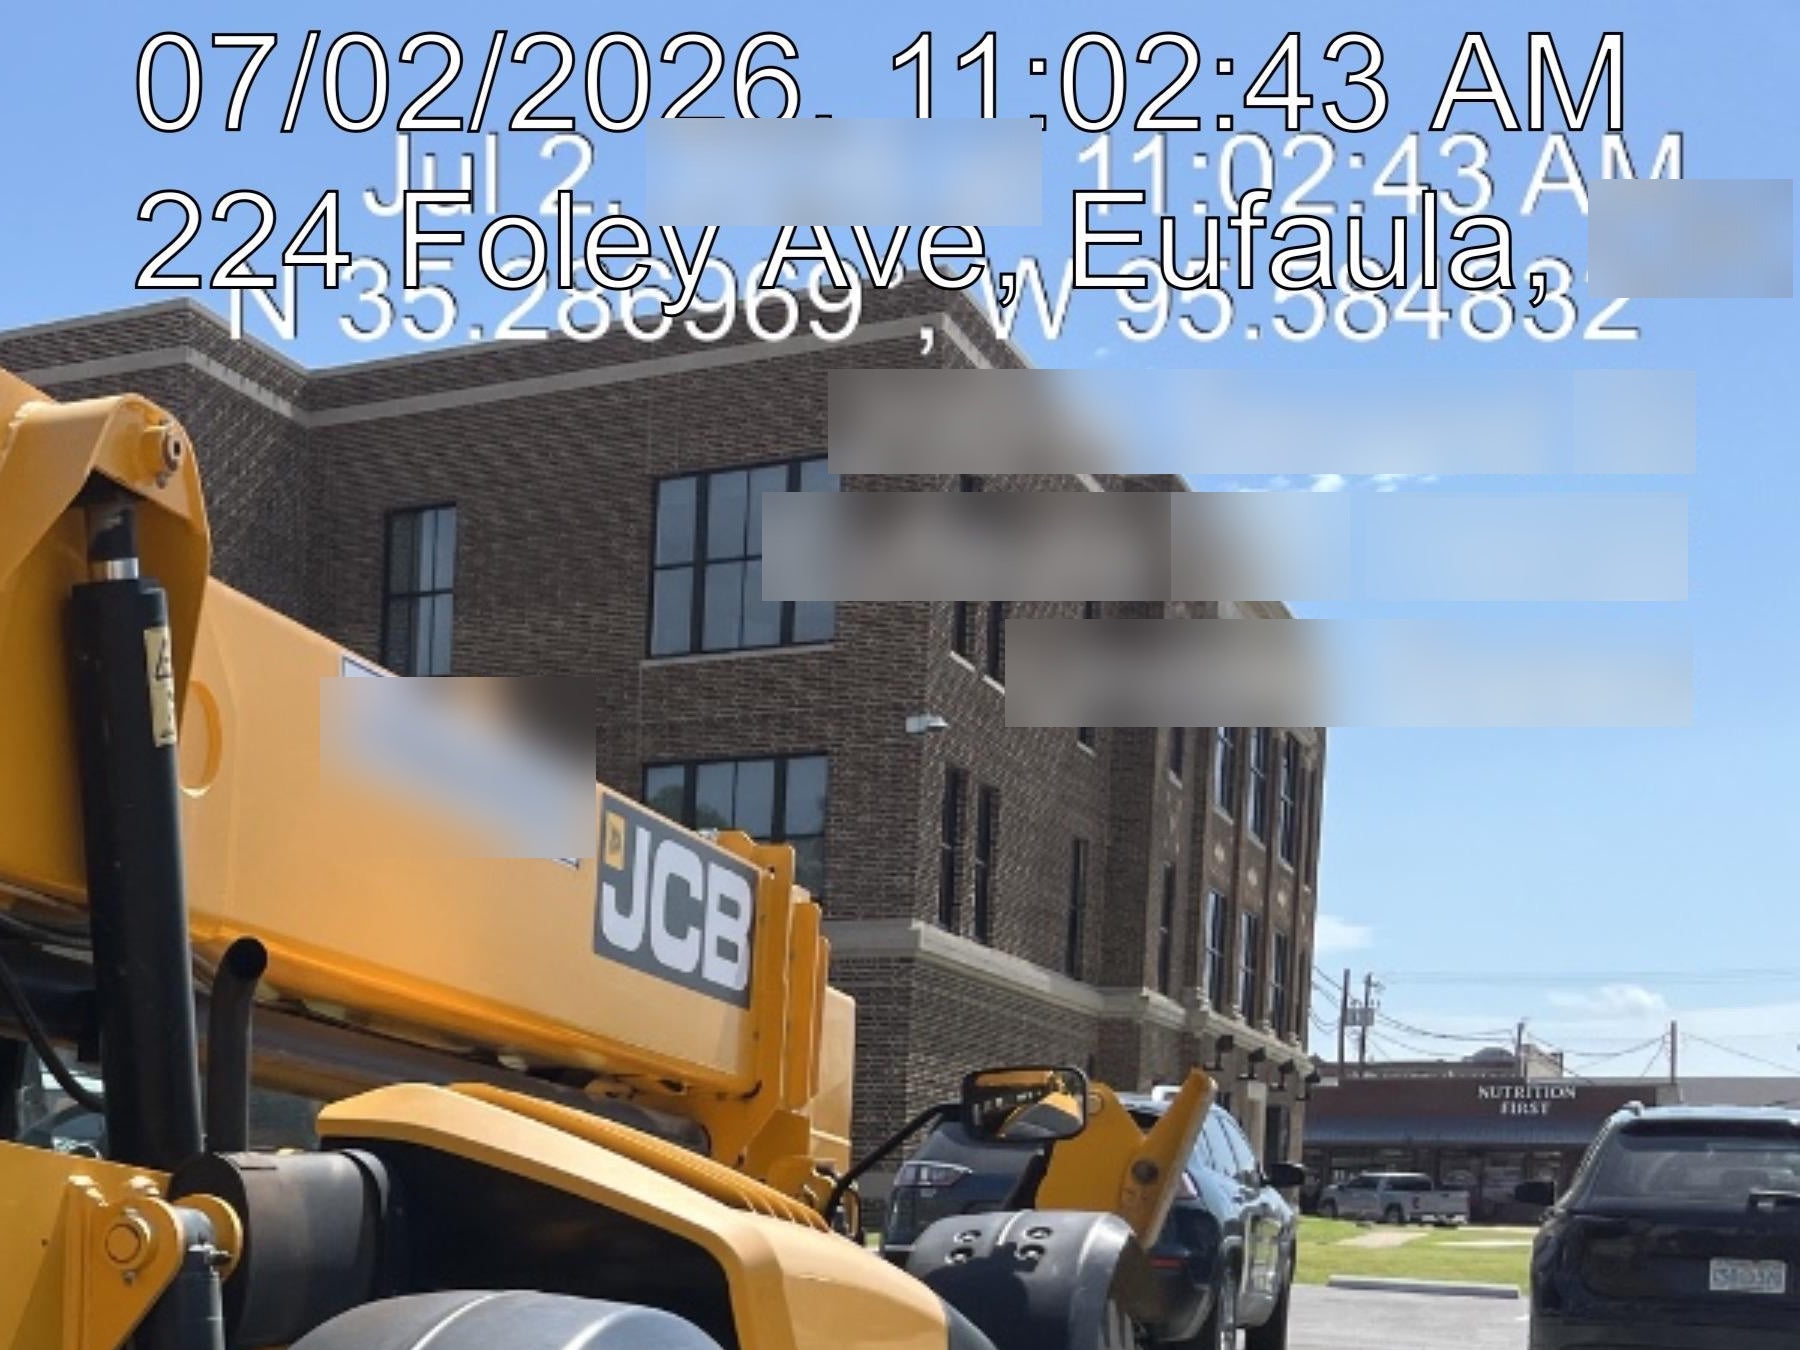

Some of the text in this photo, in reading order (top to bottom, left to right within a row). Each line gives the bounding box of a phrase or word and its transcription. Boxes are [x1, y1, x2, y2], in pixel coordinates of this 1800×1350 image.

[602, 826, 752, 991] JCB
[1477, 1085, 1577, 1100] NUTRITION
[1500, 1100, 1550, 1115] FIRST
